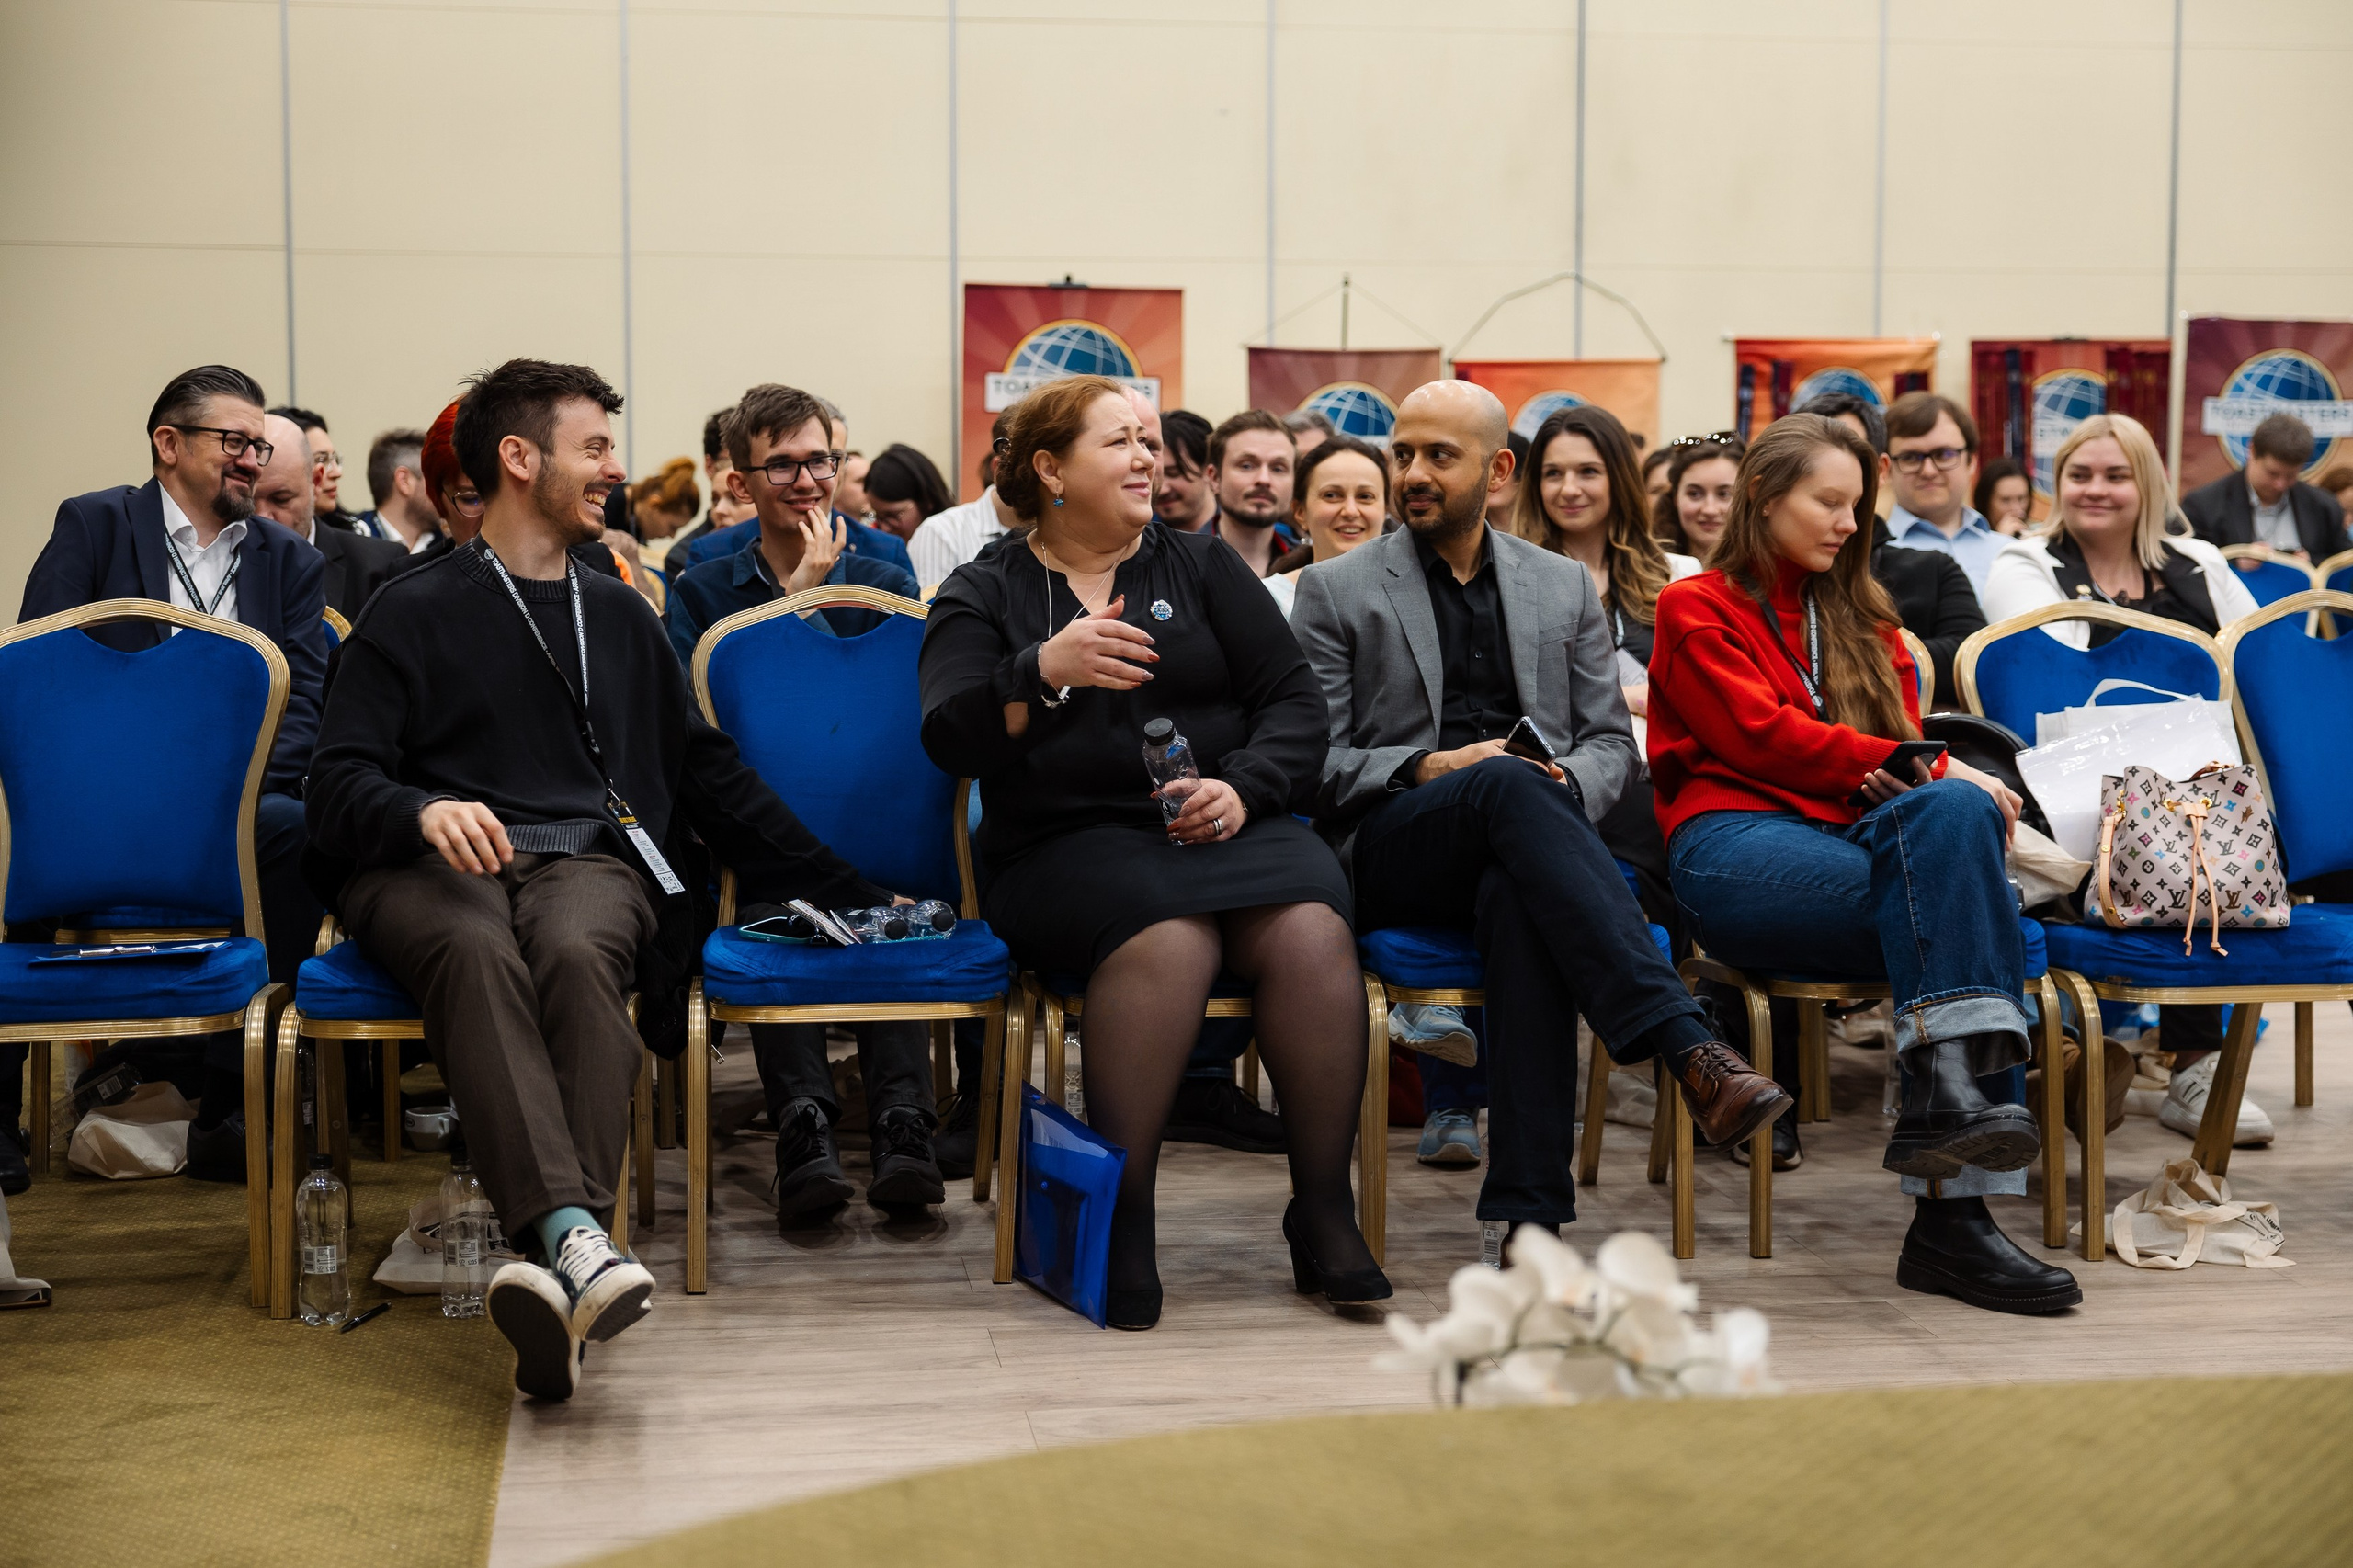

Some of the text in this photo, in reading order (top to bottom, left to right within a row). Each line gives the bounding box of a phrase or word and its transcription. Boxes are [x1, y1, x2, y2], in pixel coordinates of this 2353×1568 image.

[492, 557, 517, 594] TOASTMASTERS
[512, 592, 529, 615] DIVISION
[528, 617, 548, 651] CONFERENCE
